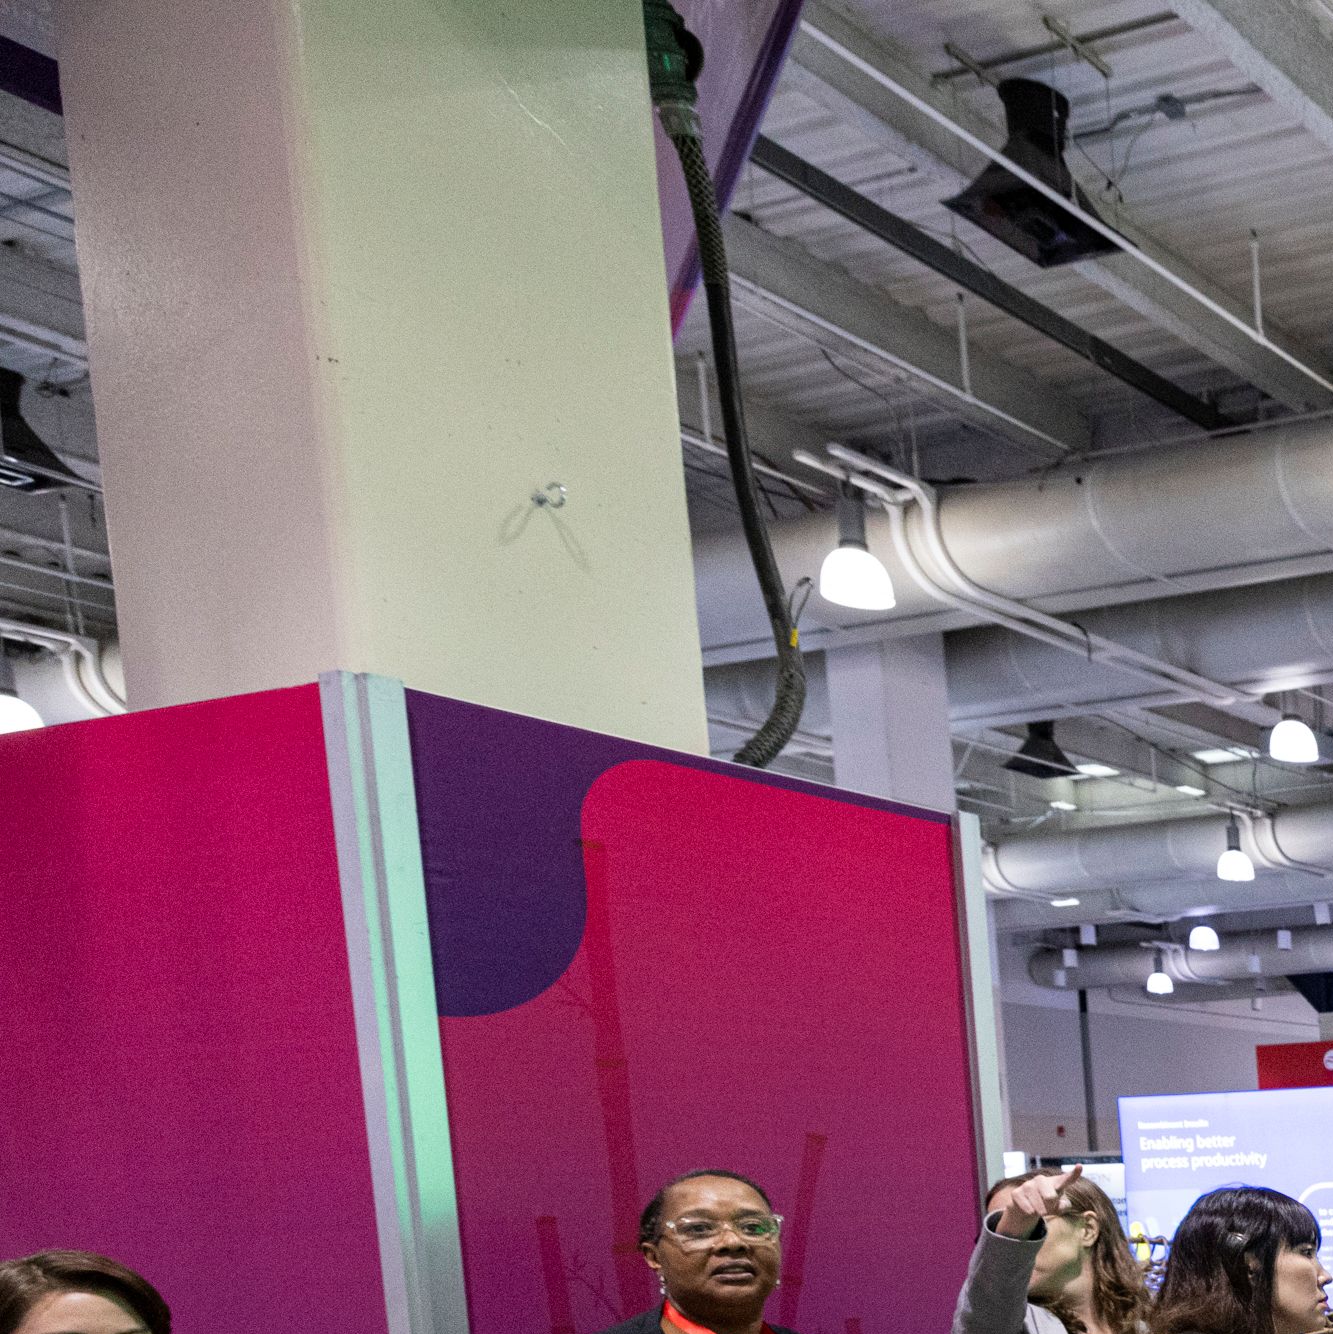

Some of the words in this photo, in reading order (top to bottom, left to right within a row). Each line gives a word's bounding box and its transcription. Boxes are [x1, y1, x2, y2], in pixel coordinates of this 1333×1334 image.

[1139, 1136, 1194, 1152] Enabling
[1196, 1134, 1236, 1149] better
[1141, 1157, 1190, 1172] process
[1191, 1151, 1267, 1171] productivity
